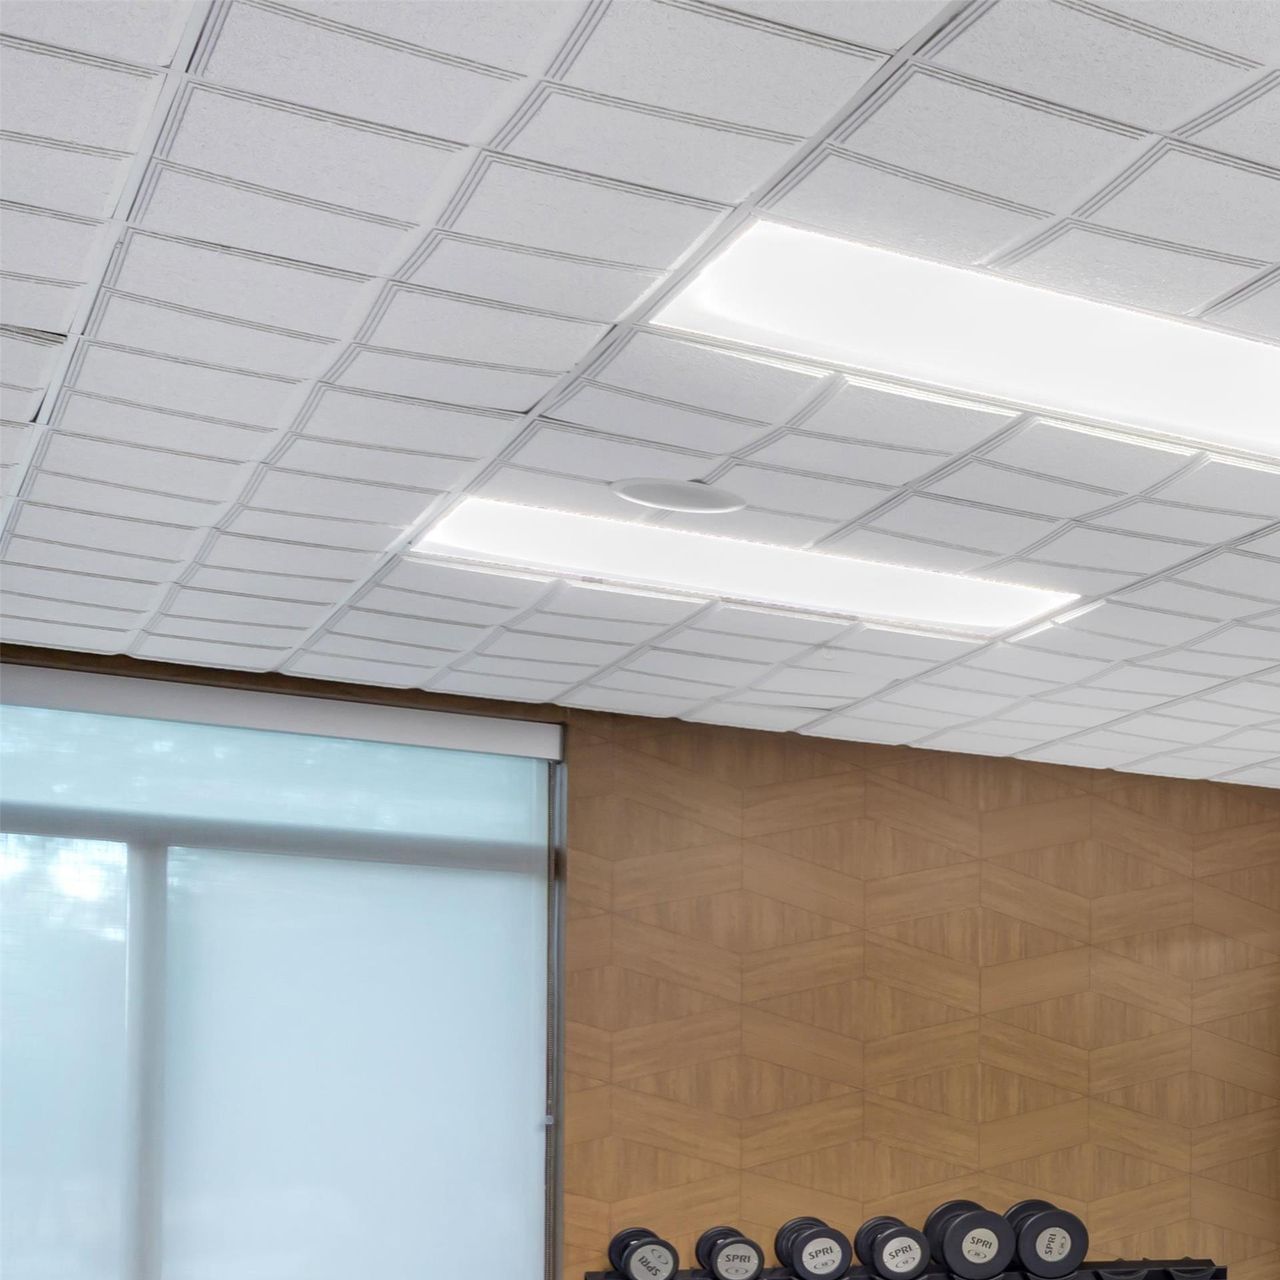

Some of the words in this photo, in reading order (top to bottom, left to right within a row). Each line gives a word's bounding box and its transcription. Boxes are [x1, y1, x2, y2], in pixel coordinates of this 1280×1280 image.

[970, 1236, 993, 1250] SPRI
[1044, 1233, 1057, 1256] SPRI
[725, 1254, 751, 1264] SPRI
[808, 1245, 834, 1260] SPRI
[888, 1244, 913, 1260] SPRI
[639, 1255, 661, 1278] SPRI
